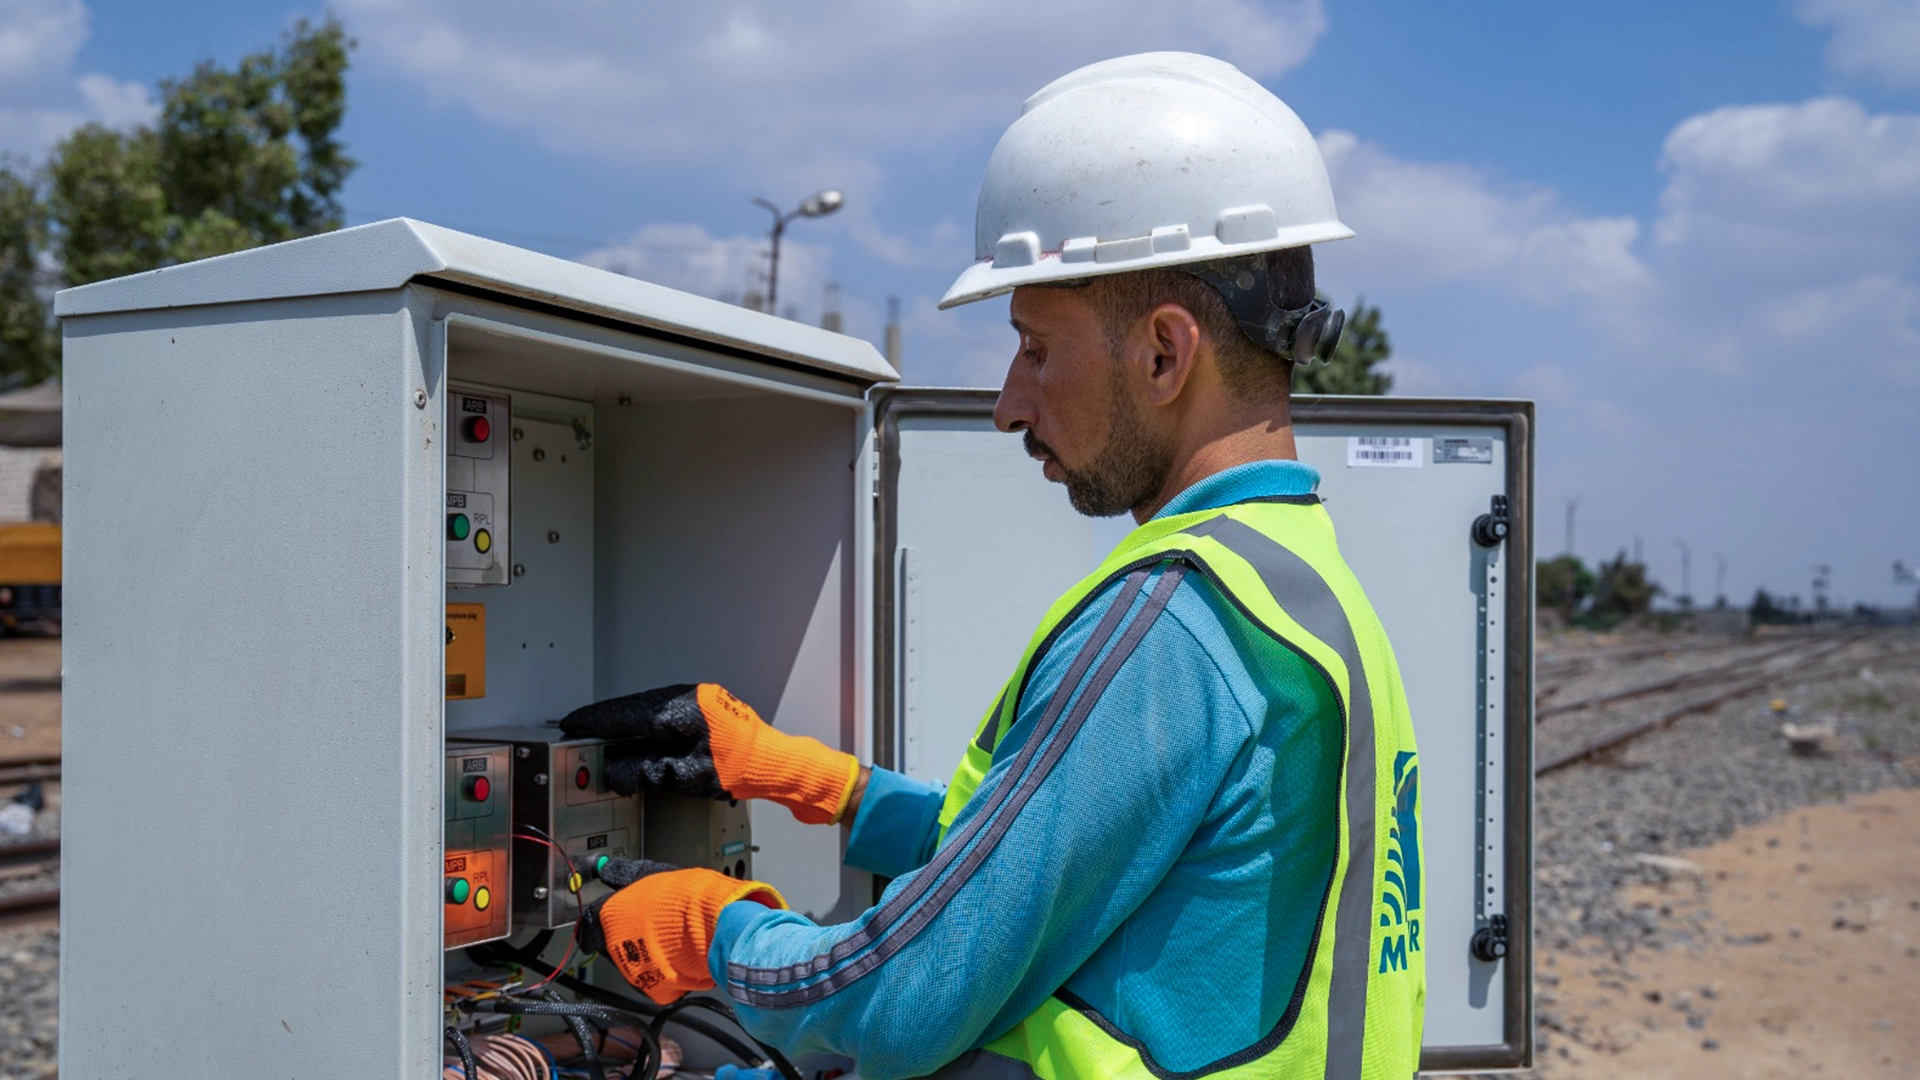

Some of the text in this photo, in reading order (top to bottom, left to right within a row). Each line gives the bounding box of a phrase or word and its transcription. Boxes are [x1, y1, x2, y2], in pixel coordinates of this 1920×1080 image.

[465, 400, 483, 412] ARB
[474, 512, 490, 524] RPL
[466, 760, 484, 771] ARB
[446, 858, 464, 872] MPB
[474, 870, 490, 882] RPL
